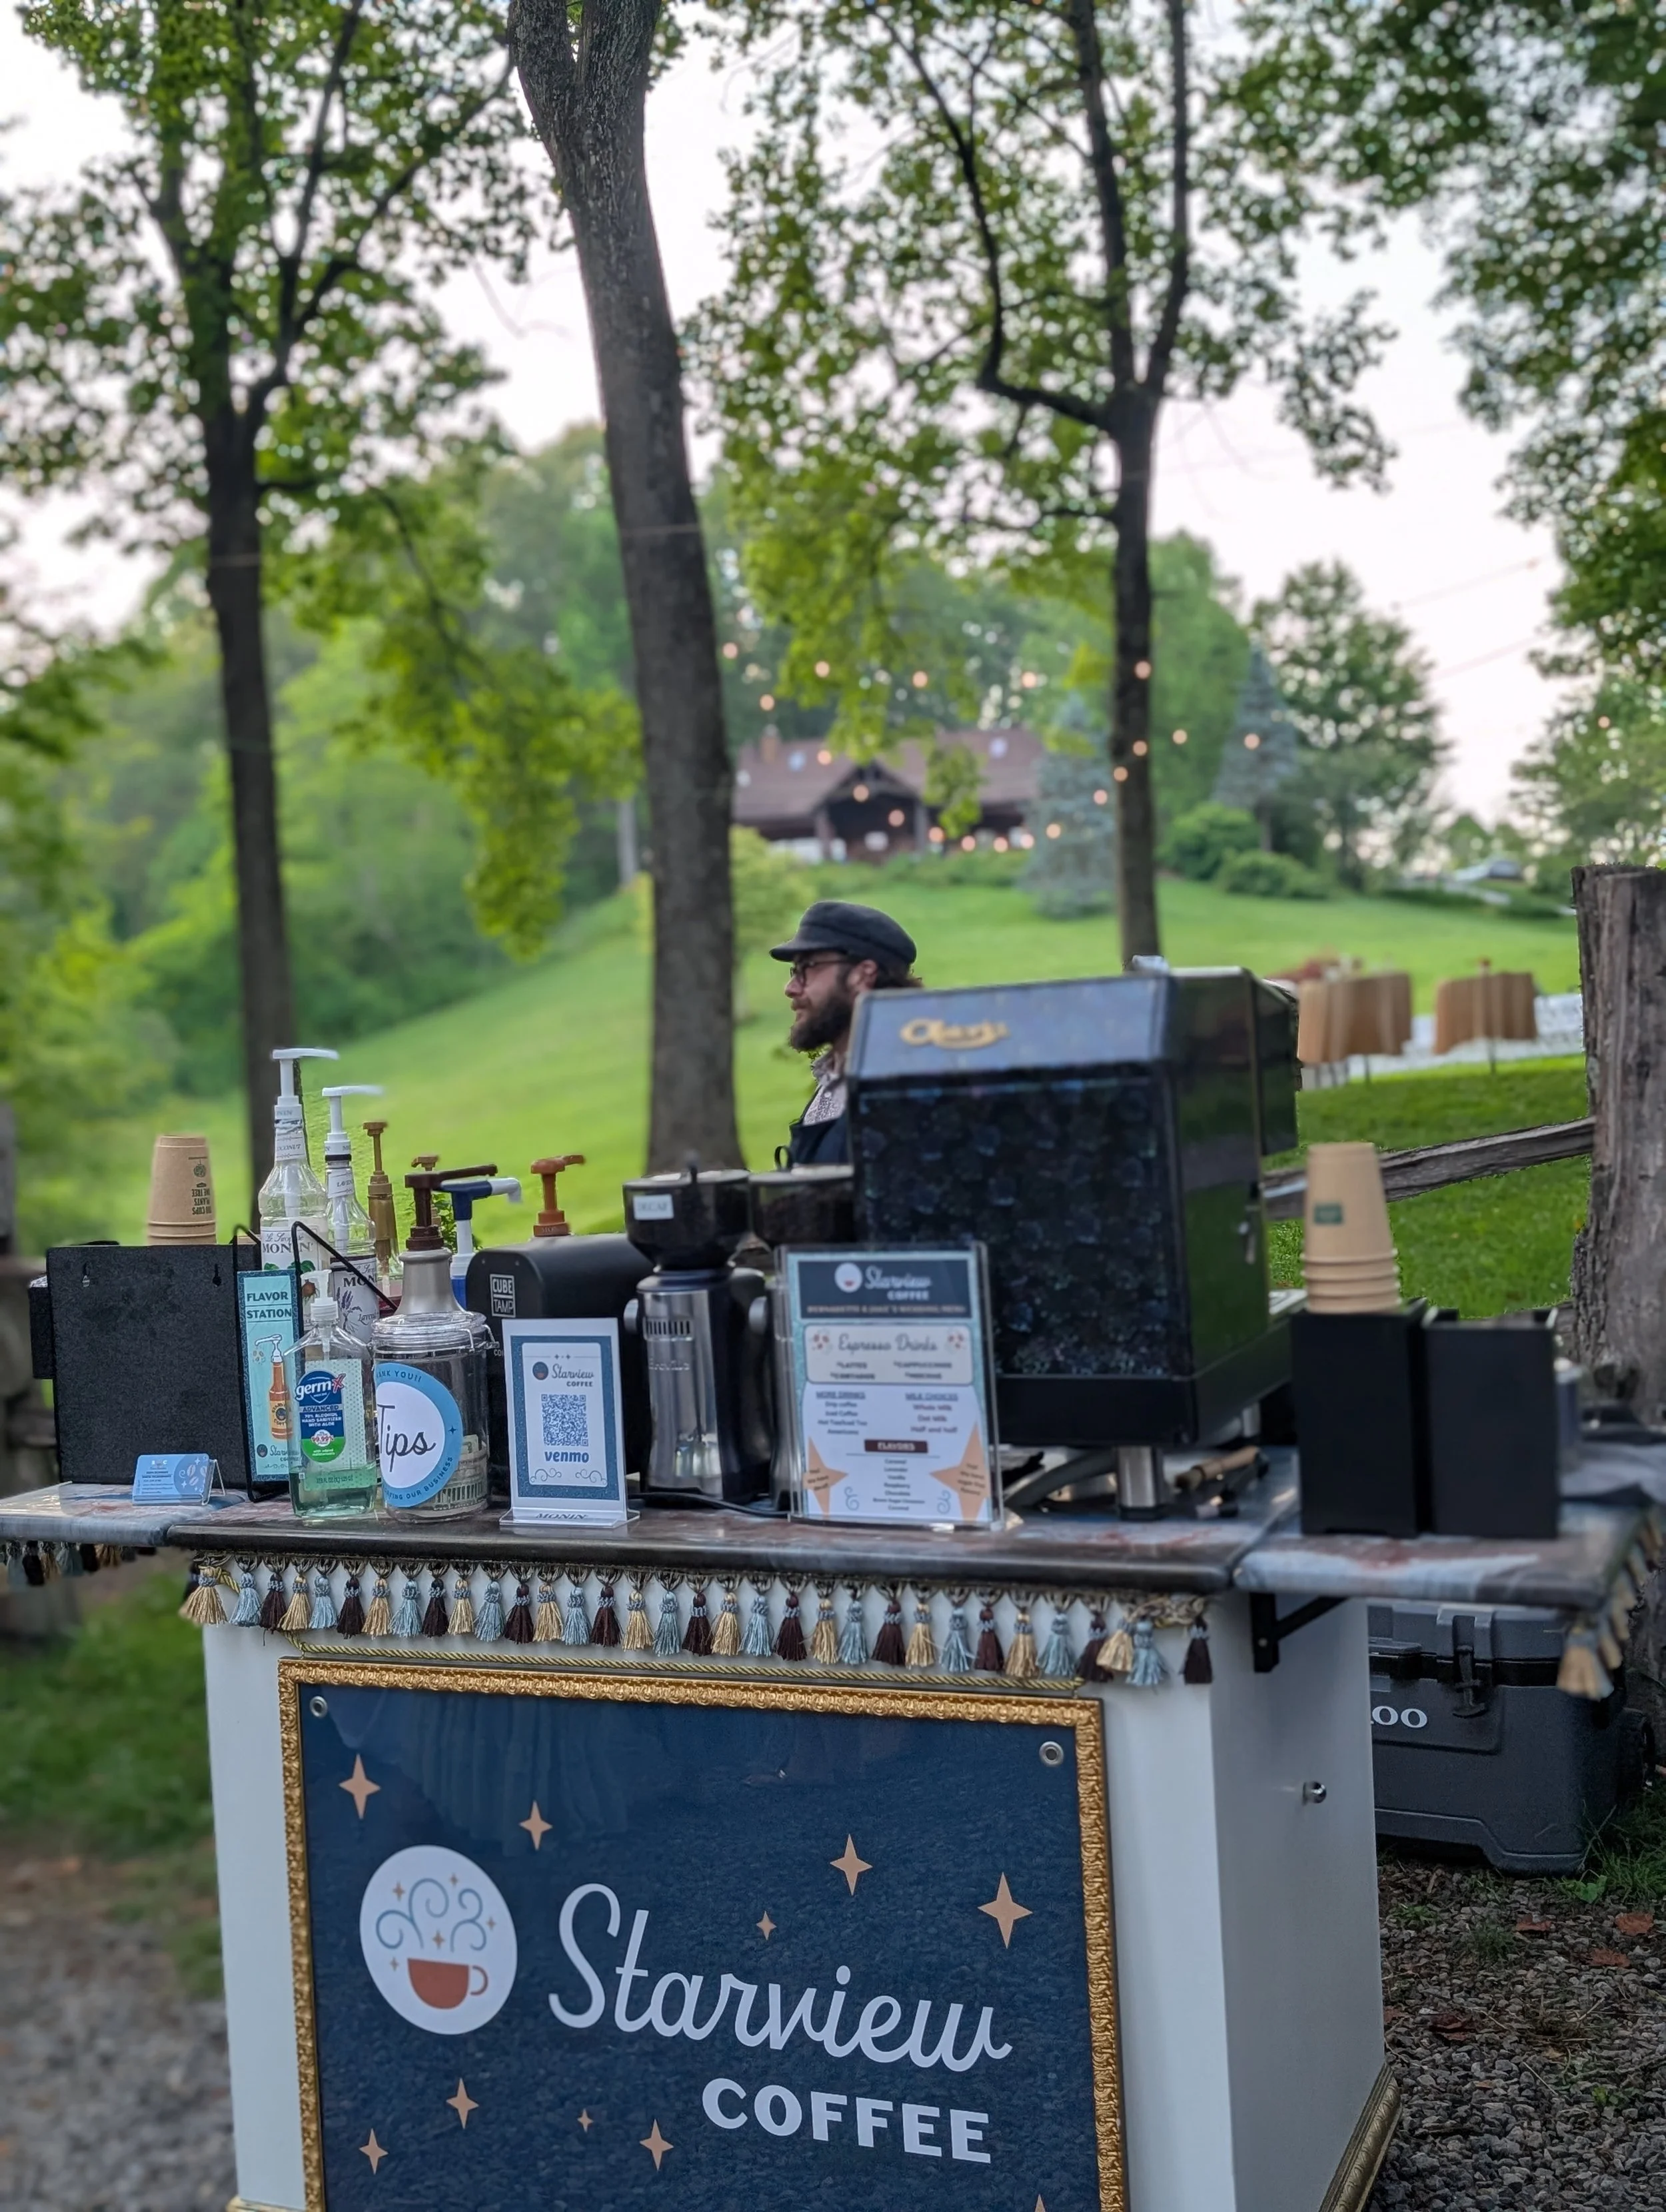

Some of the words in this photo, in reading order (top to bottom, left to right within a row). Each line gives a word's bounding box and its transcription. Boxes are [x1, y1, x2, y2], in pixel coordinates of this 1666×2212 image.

[263, 1241, 311, 1254] MONN
[493, 1278, 512, 1294] CUBE
[247, 1291, 289, 1302] FLAVOR
[887, 1291, 930, 1301] COFFEE
[247, 1308, 292, 1319] STATION
[494, 1299, 513, 1313] TAMP
[838, 1333, 892, 1355] Espresso
[895, 1333, 938, 1351] Drinks
[395, 1370, 422, 1382] YOU!!
[552, 1363, 594, 1379] Starview
[377, 1404, 436, 1472] Tips
[544, 1451, 589, 1463] venmo
[406, 1490, 422, 1499] OUR
[423, 1456, 453, 1492] BUSINESS
[1370, 1706, 1427, 1728] OO
[548, 1883, 1013, 2072] Starview
[702, 2077, 992, 2164] COFFEE
